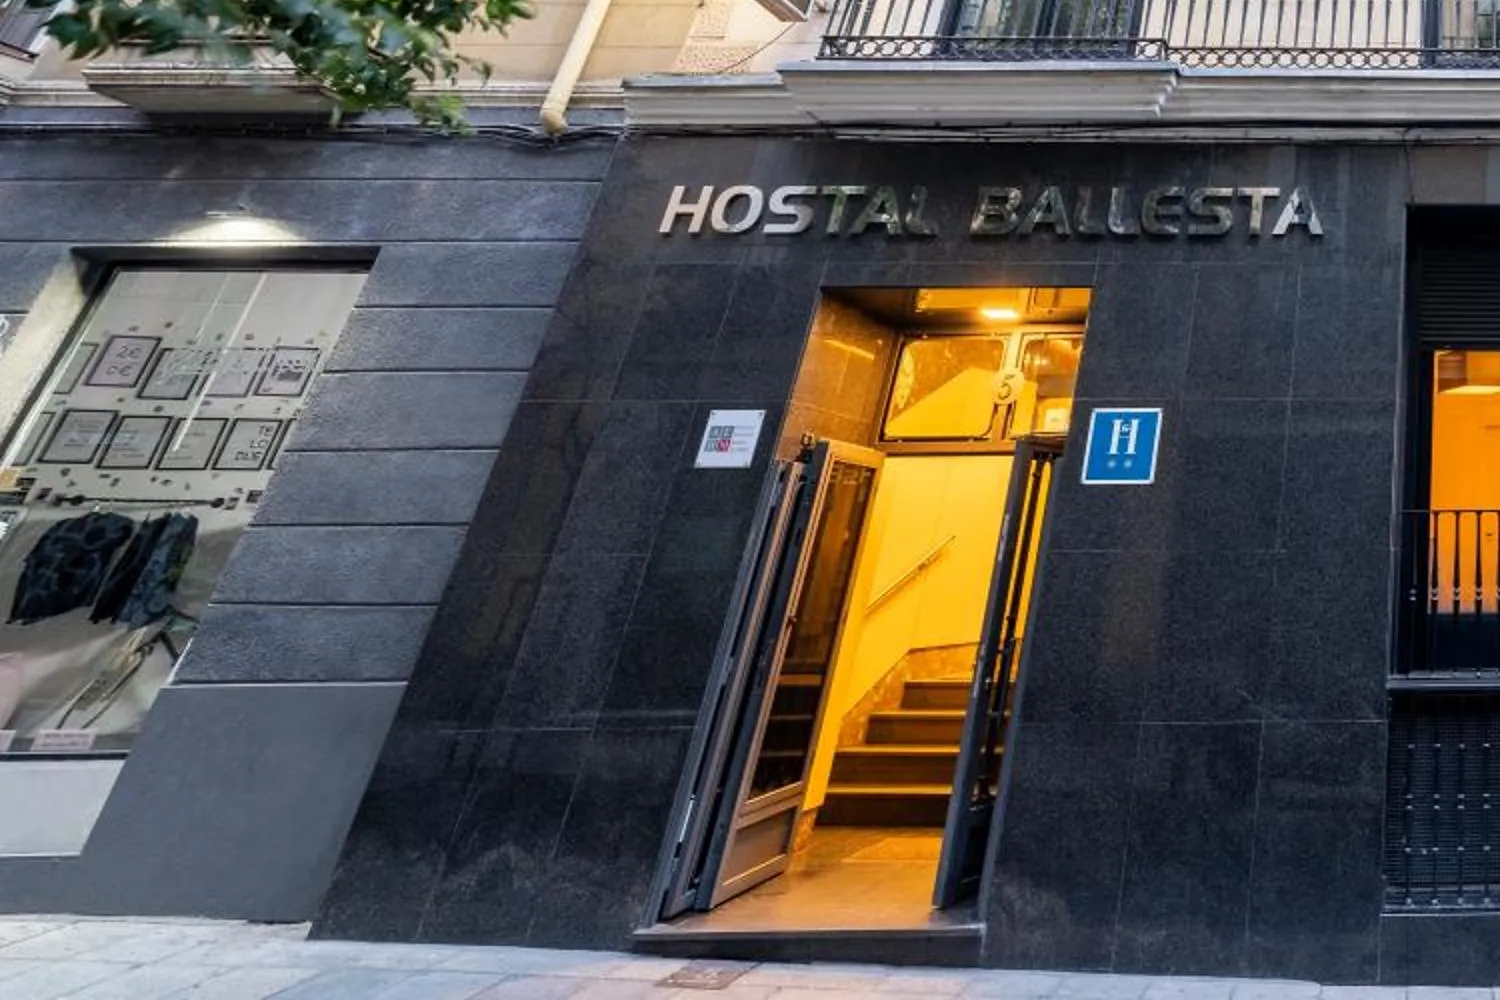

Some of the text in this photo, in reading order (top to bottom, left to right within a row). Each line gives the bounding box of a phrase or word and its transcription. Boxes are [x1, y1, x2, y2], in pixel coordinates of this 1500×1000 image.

[658, 184, 1325, 237] HOSTAL BALLESTA
[997, 373, 1017, 399] 5
